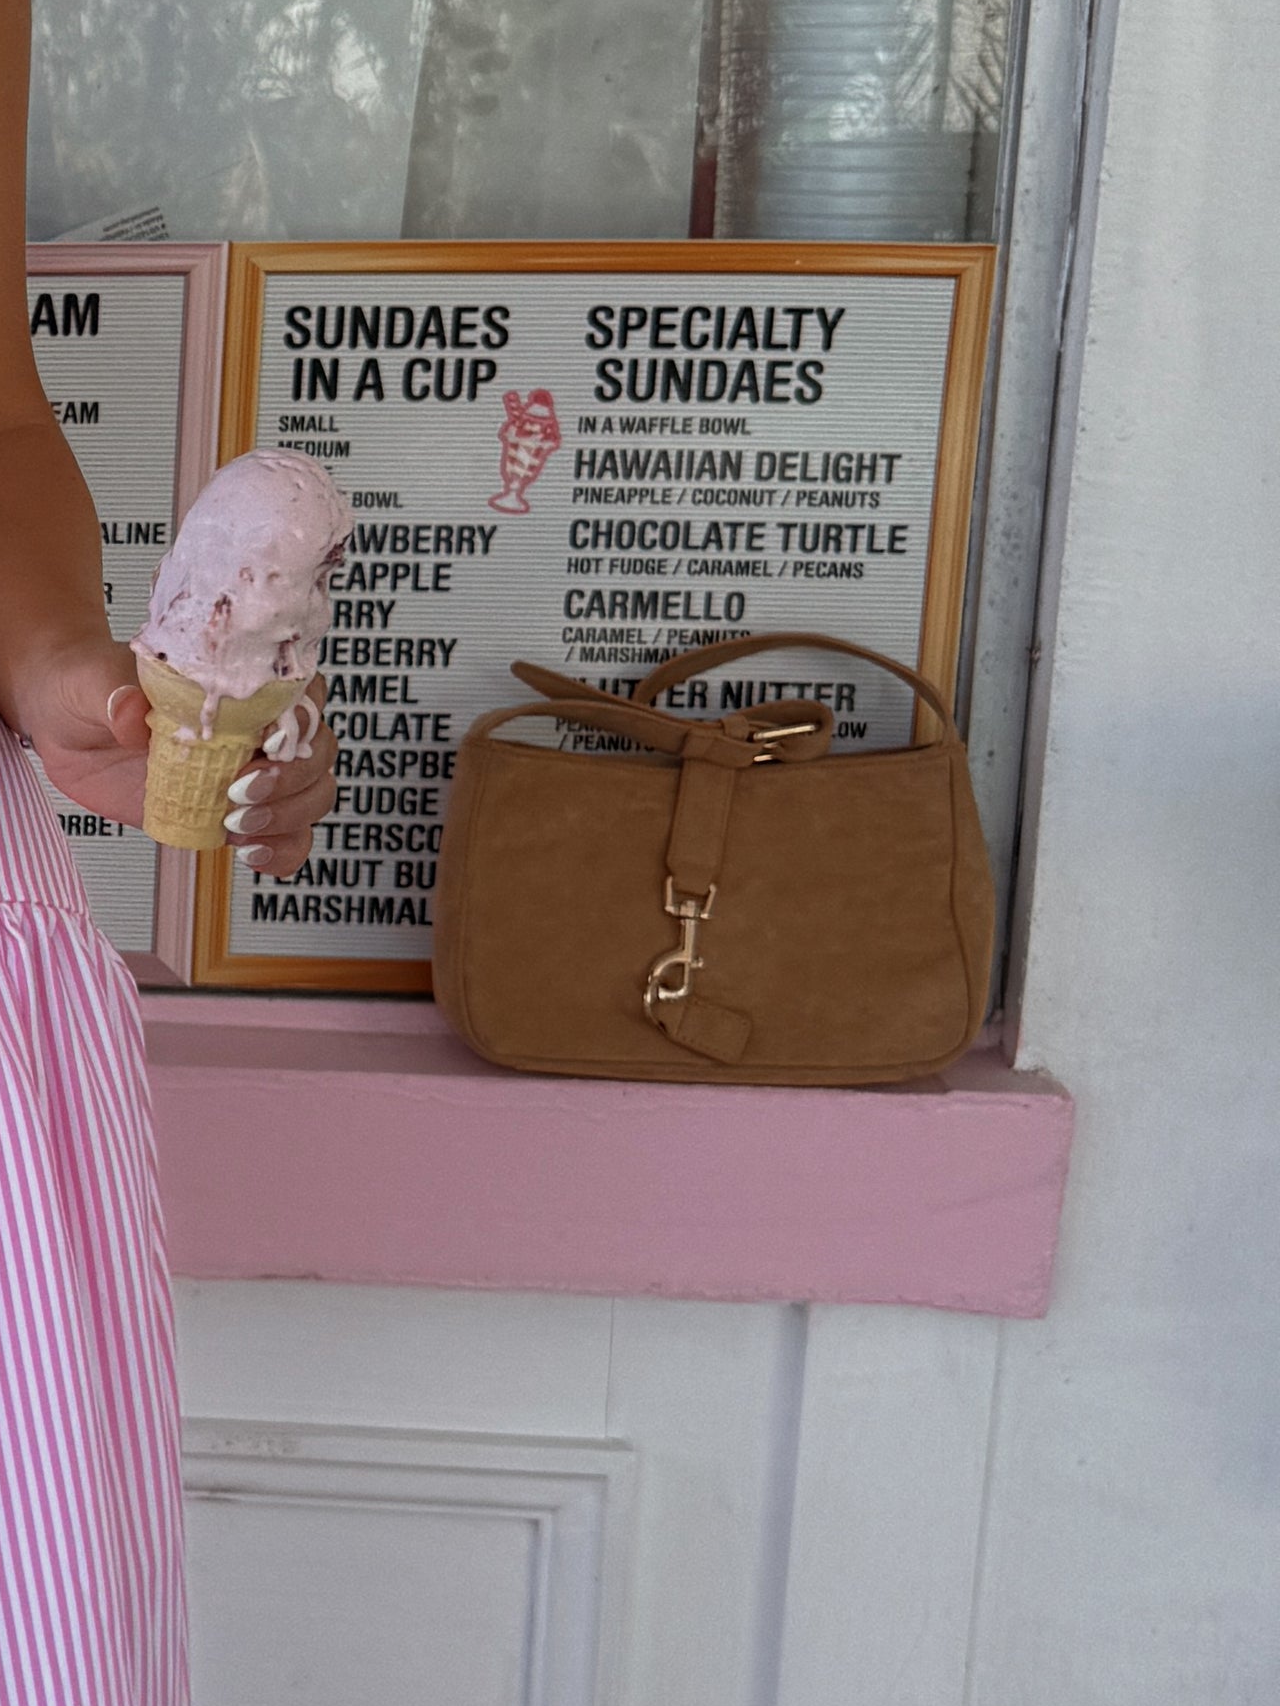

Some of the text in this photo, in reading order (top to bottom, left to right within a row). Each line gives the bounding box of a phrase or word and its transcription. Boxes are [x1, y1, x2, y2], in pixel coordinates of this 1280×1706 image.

[283, 305, 510, 350] SUNDAES
[585, 305, 845, 352] SPECIALTY
[292, 357, 498, 403] IN A CUP
[594, 358, 824, 405] SUNDAES
[278, 415, 339, 433] SMALL
[577, 416, 751, 436] IN A WAFFLE BOWL
[573, 449, 902, 484] HAWAIIAN DELIGHT
[352, 491, 403, 508] BOWL
[572, 487, 880, 509] PINEAPPLE COCONUT PEANUTS
[568, 519, 909, 555] CHOCOLATE TURTLE
[566, 557, 864, 579] HOT FUDGE CARAMEL PECANS
[563, 589, 746, 622] CARMELLO
[562, 627, 647, 644] CARAMEL
[333, 785, 439, 815] FUDGE
